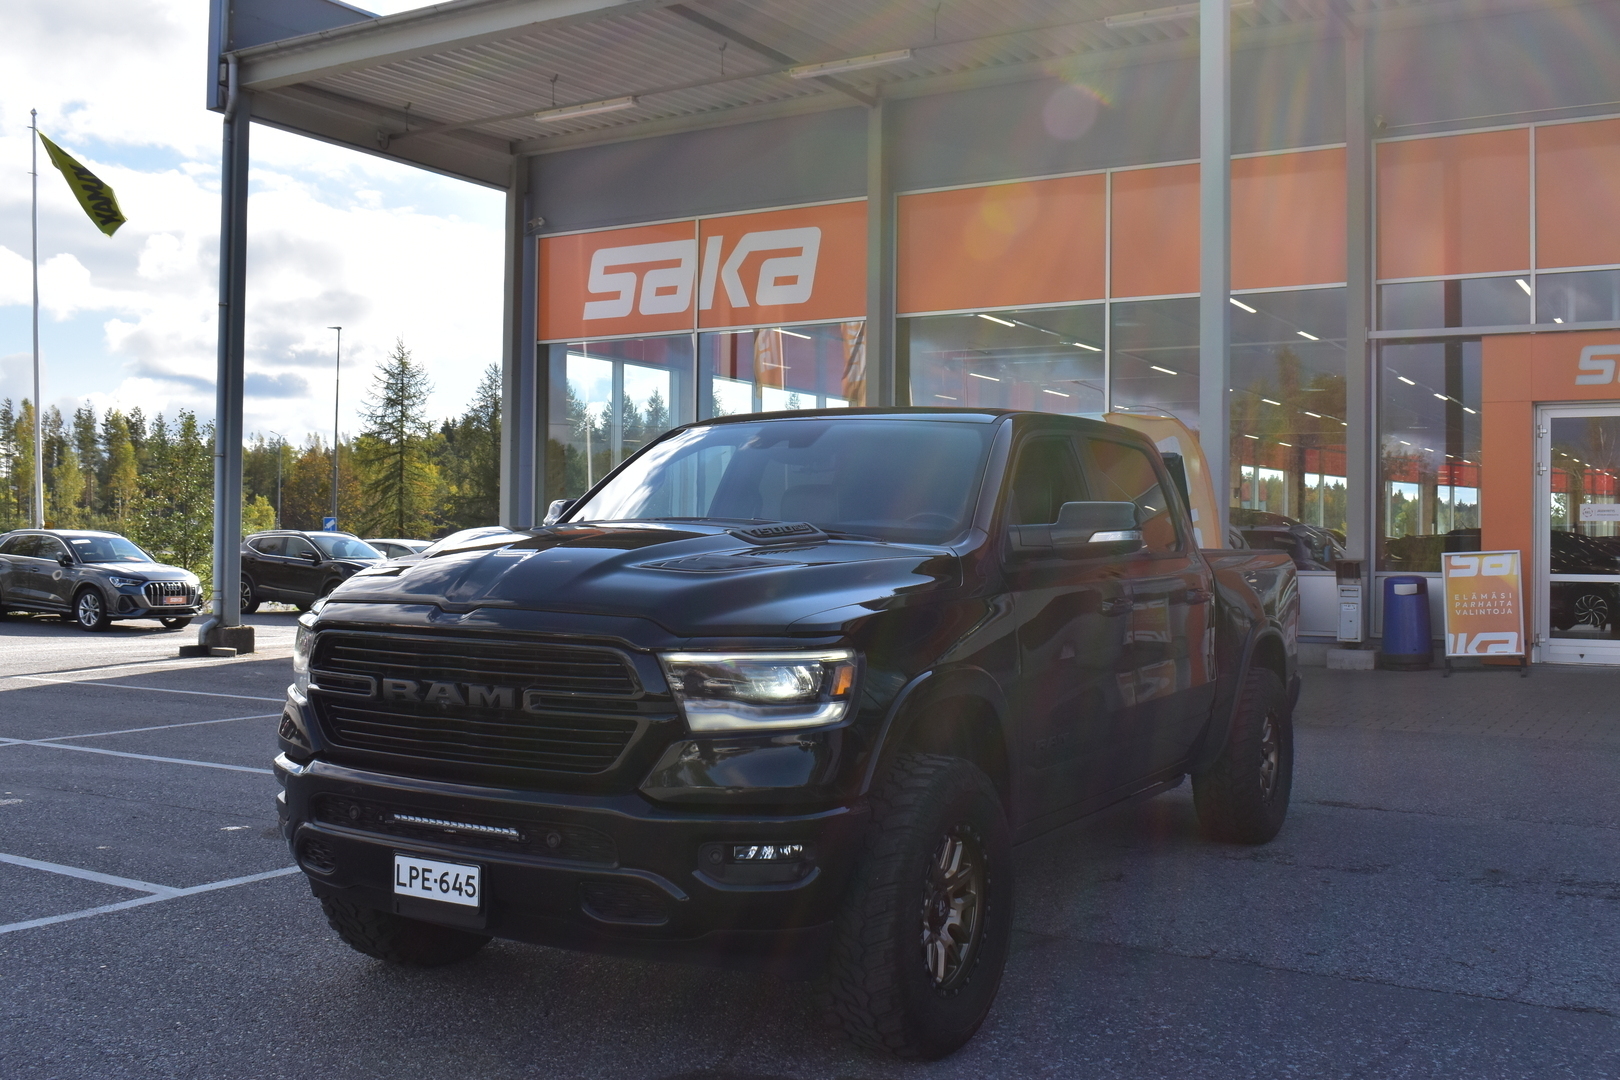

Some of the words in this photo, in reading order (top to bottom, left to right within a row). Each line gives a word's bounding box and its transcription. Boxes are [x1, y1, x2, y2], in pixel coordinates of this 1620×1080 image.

[1454, 592, 1512, 600] ELÄMÄSI
[1455, 600, 1512, 608] PARHAITA
[1455, 608, 1513, 616] VALINTOJA
[382, 677, 515, 709] RAM
[396, 863, 477, 898] LPE-645
